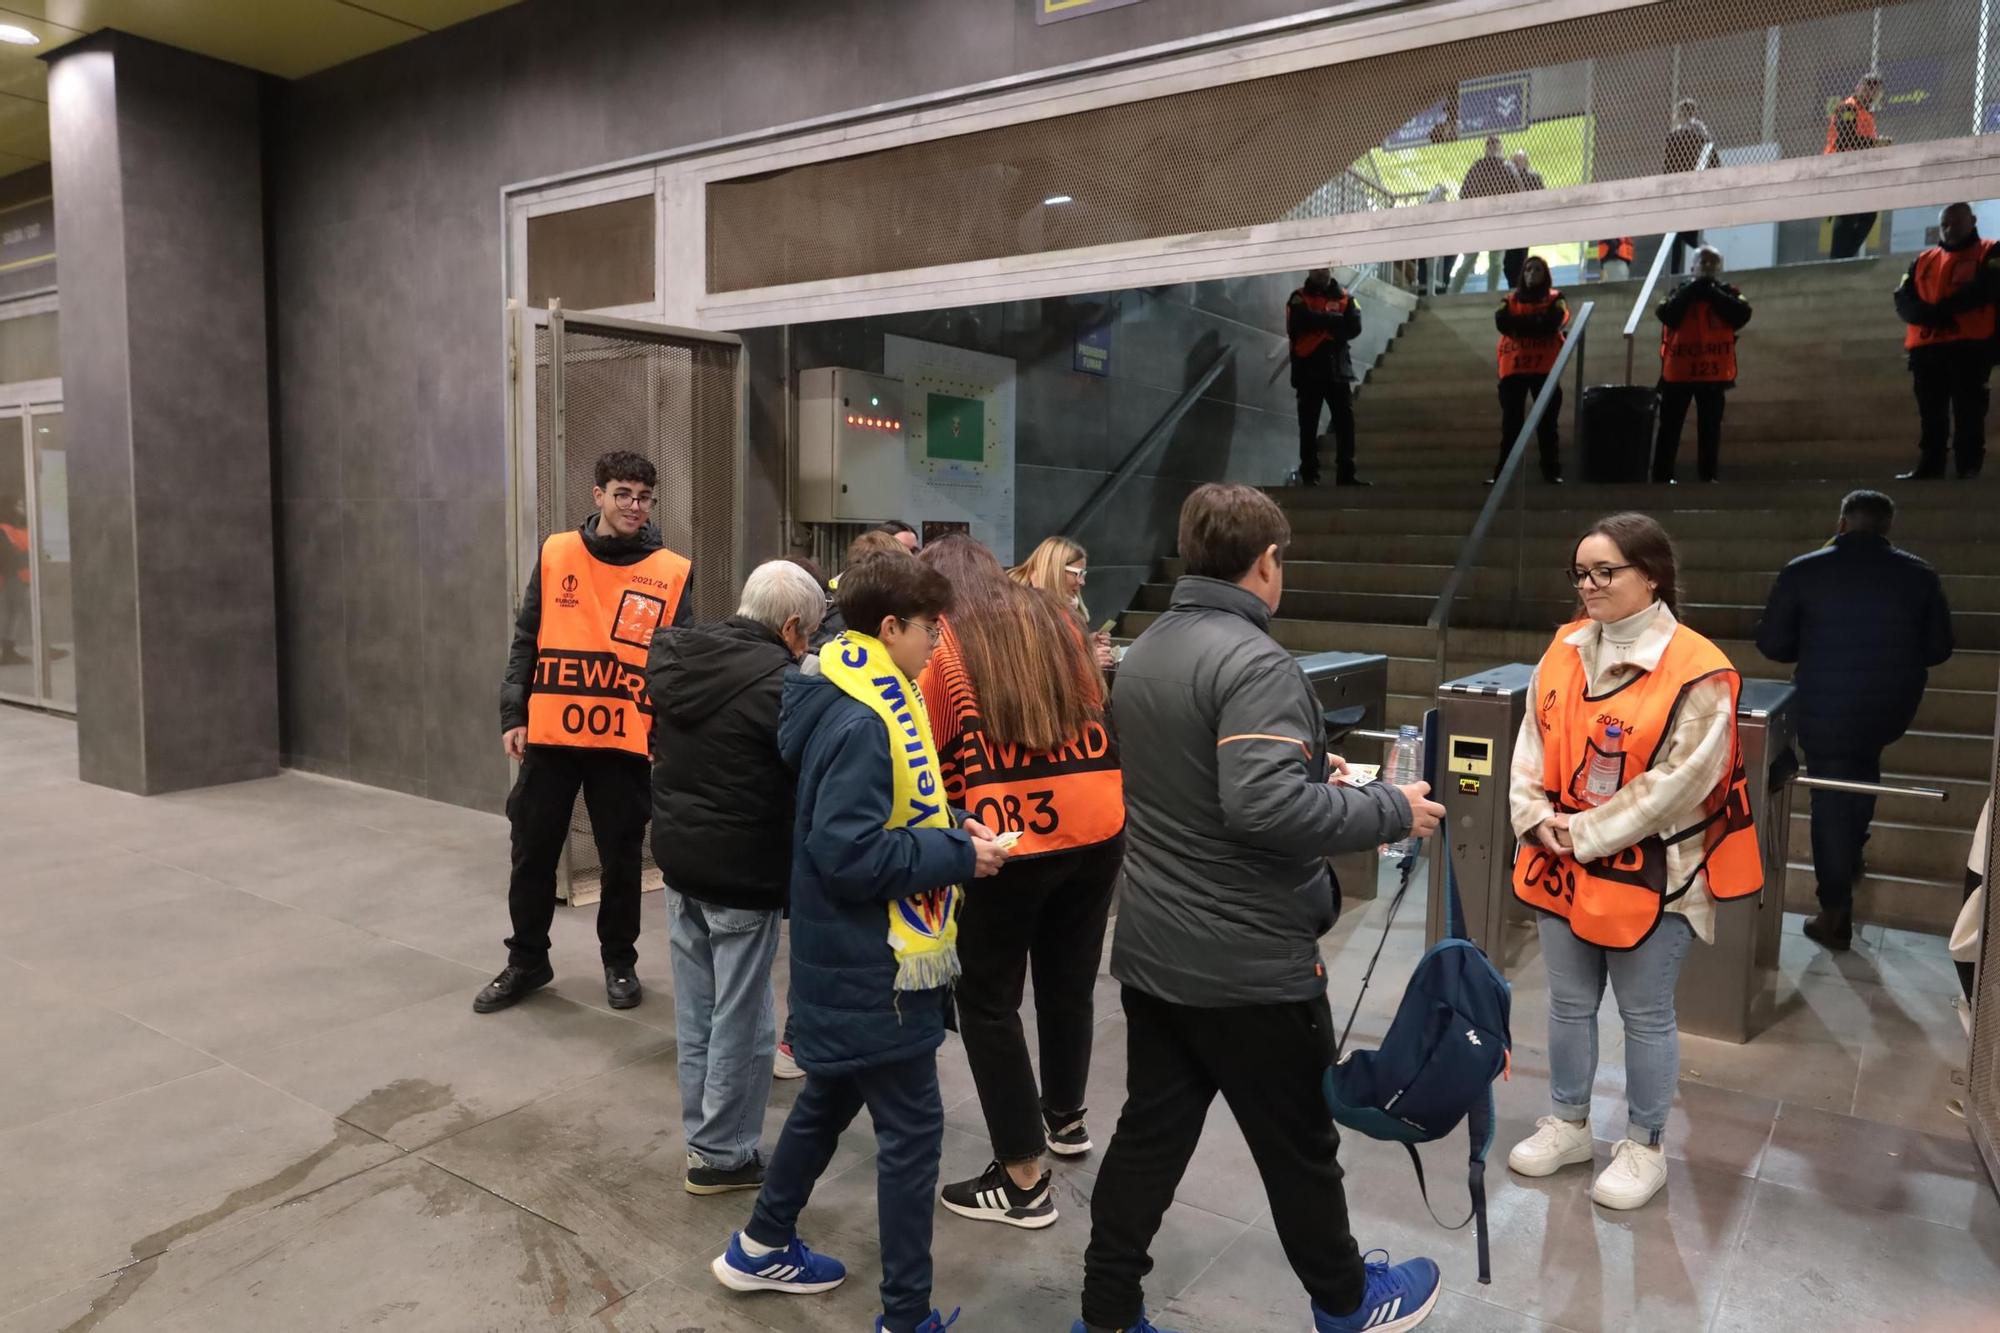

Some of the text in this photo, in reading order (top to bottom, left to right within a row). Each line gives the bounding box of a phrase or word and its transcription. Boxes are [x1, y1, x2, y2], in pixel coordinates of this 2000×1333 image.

[632, 575, 668, 590] 2021/24
[533, 656, 653, 706] TEWAR
[562, 703, 626, 738] 001
[975, 790, 1059, 839] 083
[1524, 851, 1576, 906] 059
